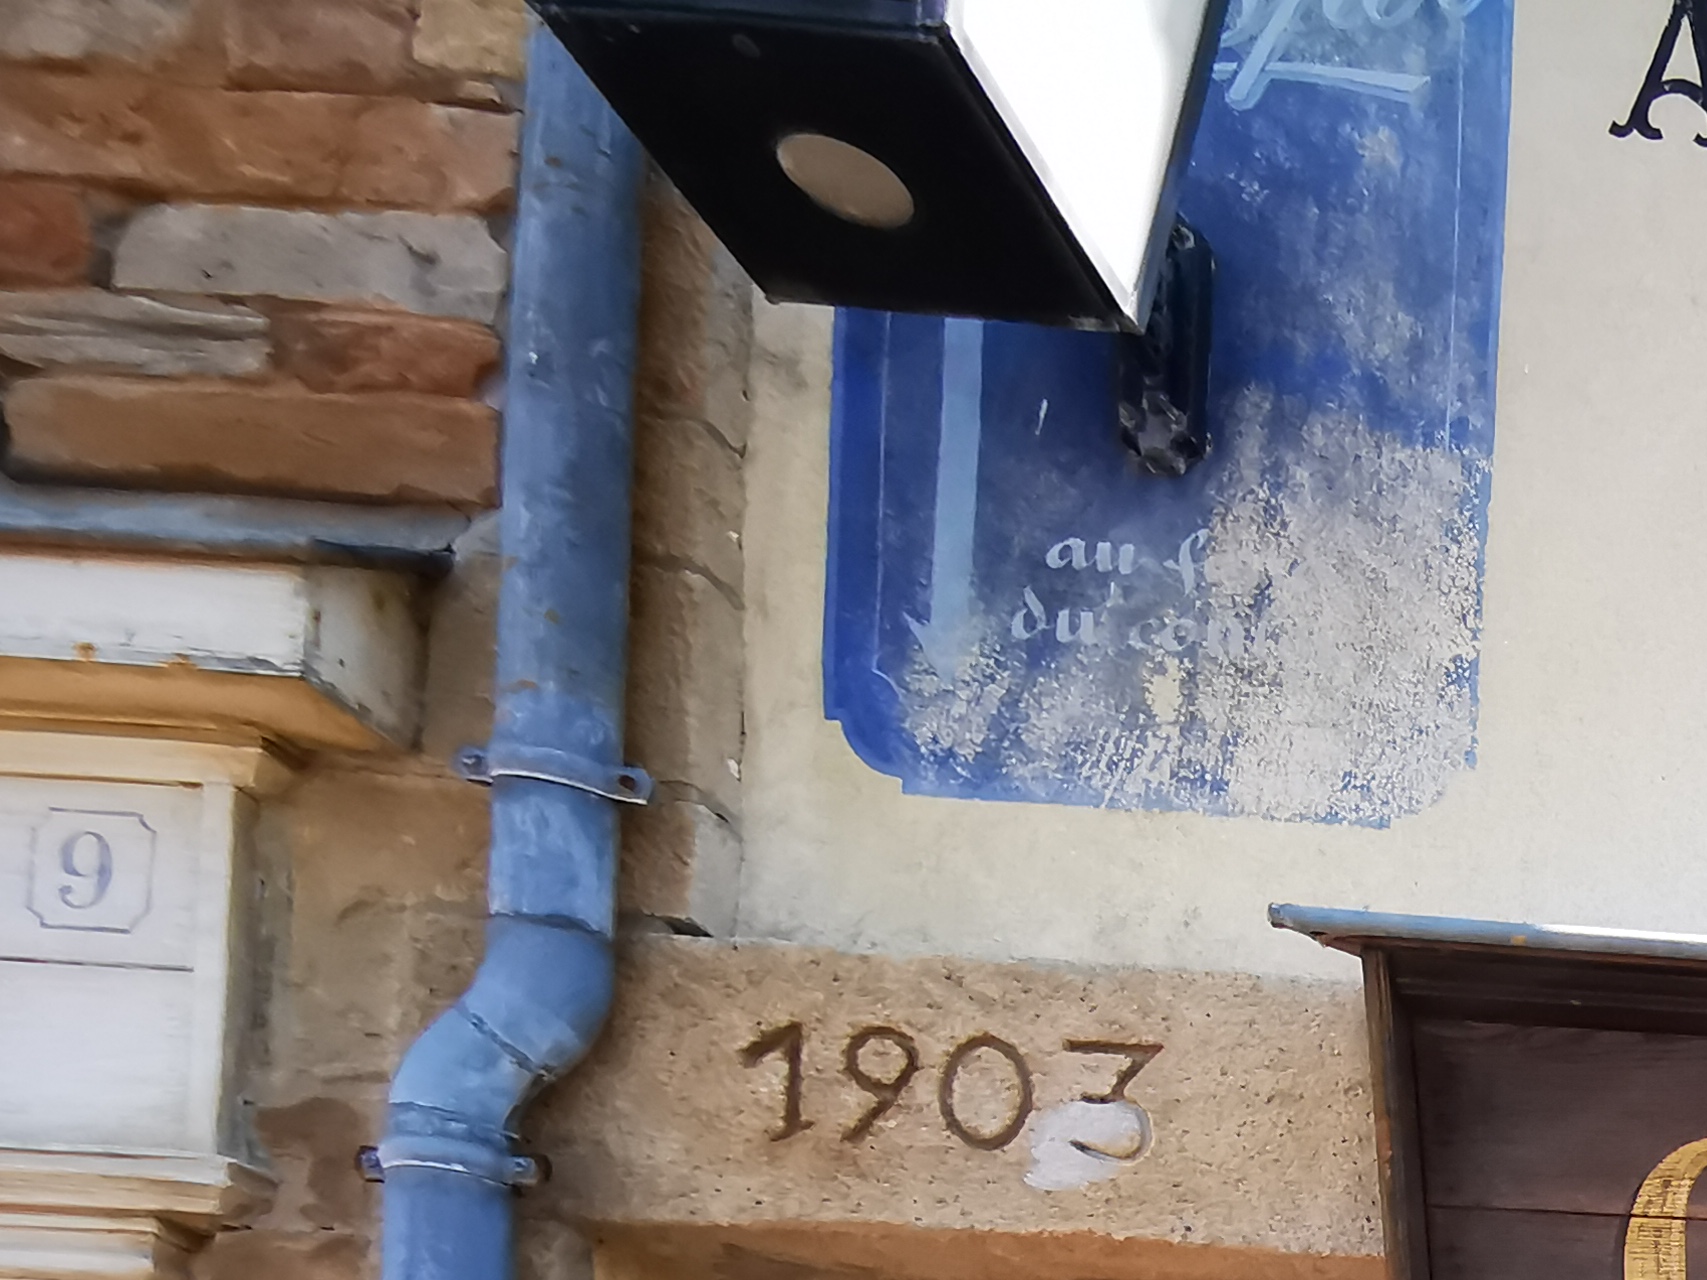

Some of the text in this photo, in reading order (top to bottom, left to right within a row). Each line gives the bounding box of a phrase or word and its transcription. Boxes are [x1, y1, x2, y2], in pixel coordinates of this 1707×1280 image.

[1045, 536, 1135, 575] au
[57, 831, 113, 910] 9
[738, 1019, 1164, 1162] 1903
